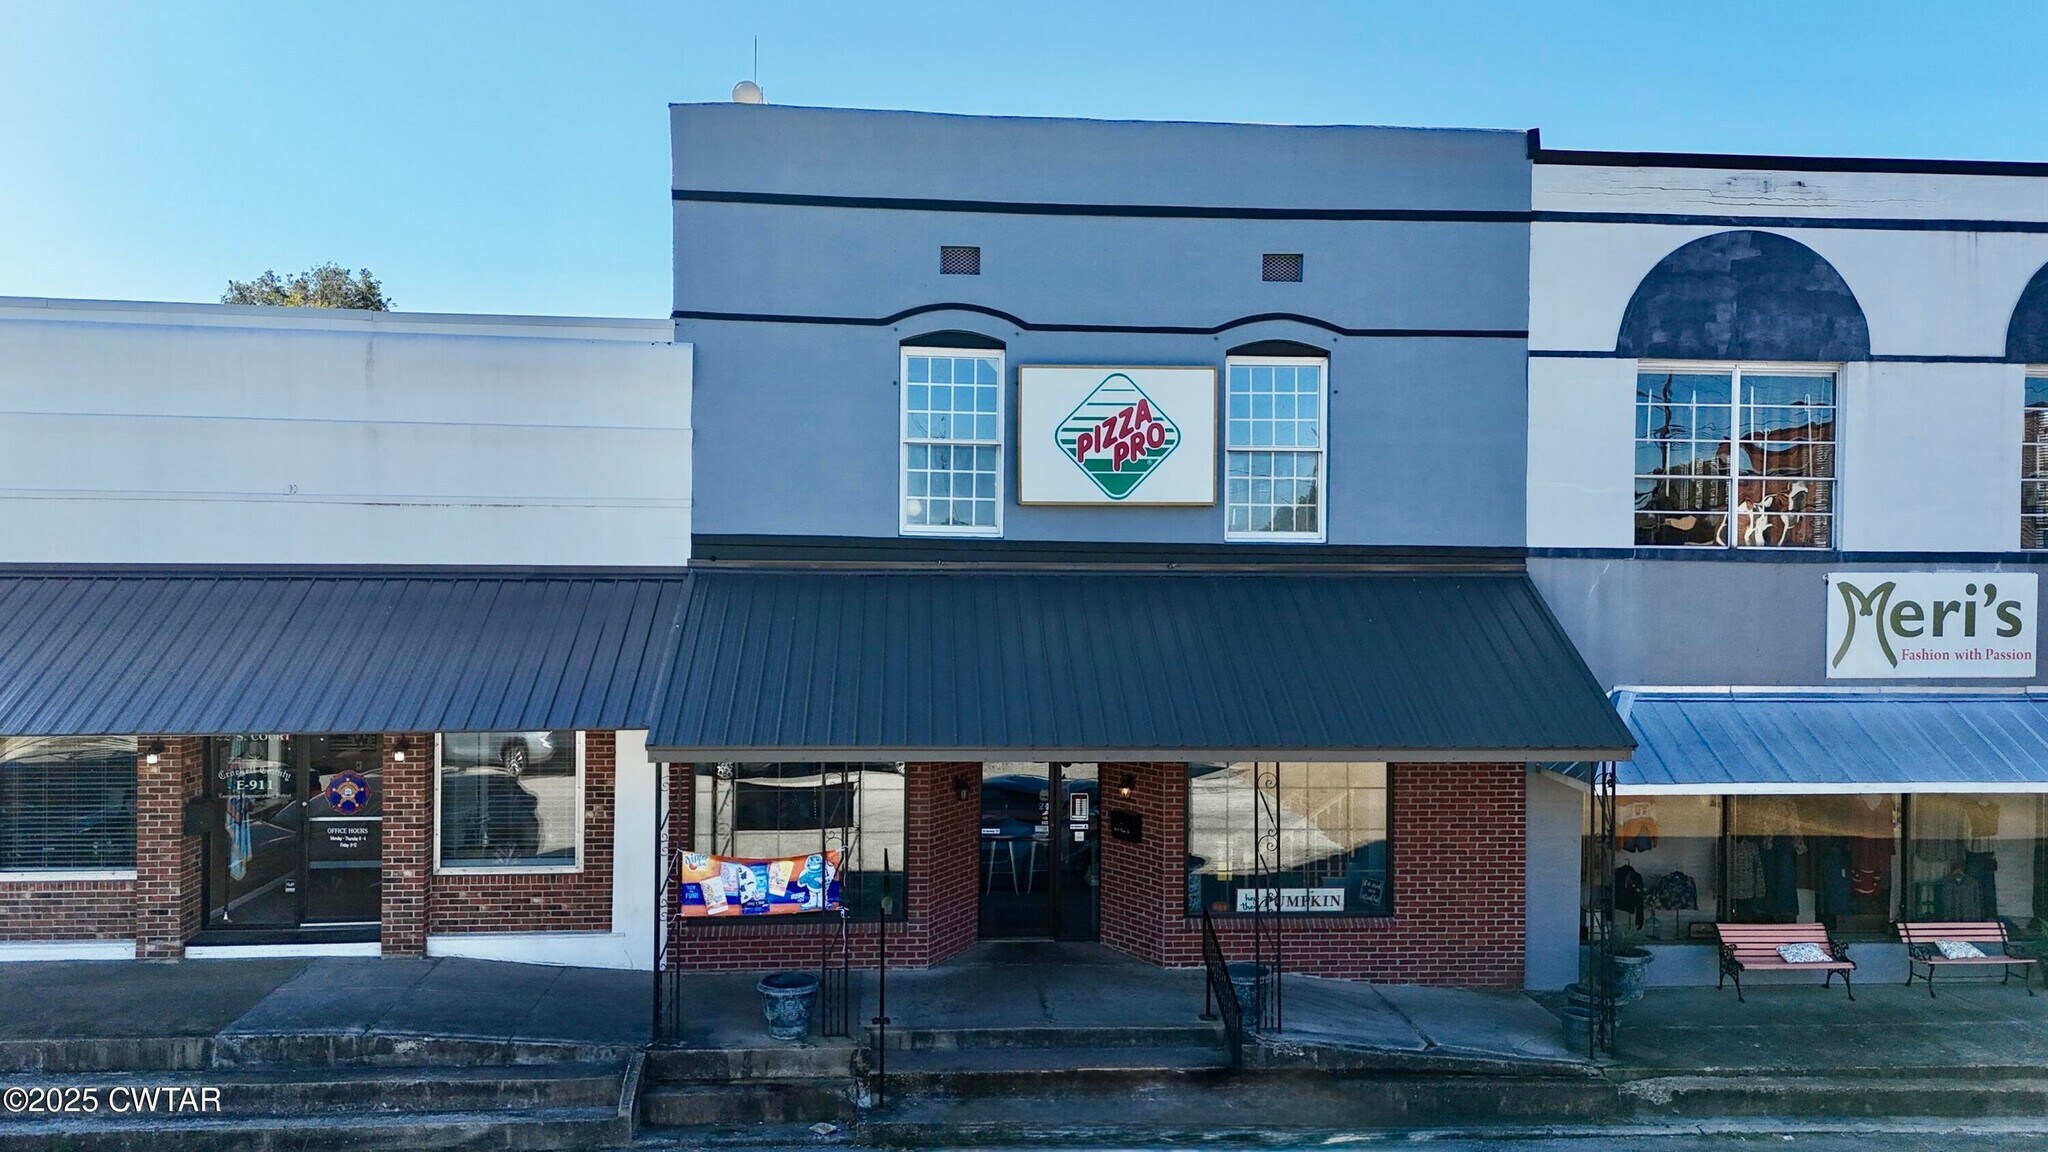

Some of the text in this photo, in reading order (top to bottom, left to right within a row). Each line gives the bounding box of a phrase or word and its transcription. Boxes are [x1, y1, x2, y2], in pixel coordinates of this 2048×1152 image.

[1077, 398, 1152, 463] PIZZA
[1113, 422, 1166, 472] PRO
[1832, 581, 2023, 669] Meri's
[1901, 648, 2032, 661] Fashion with Passion
[236, 780, 274, 791] E-911
